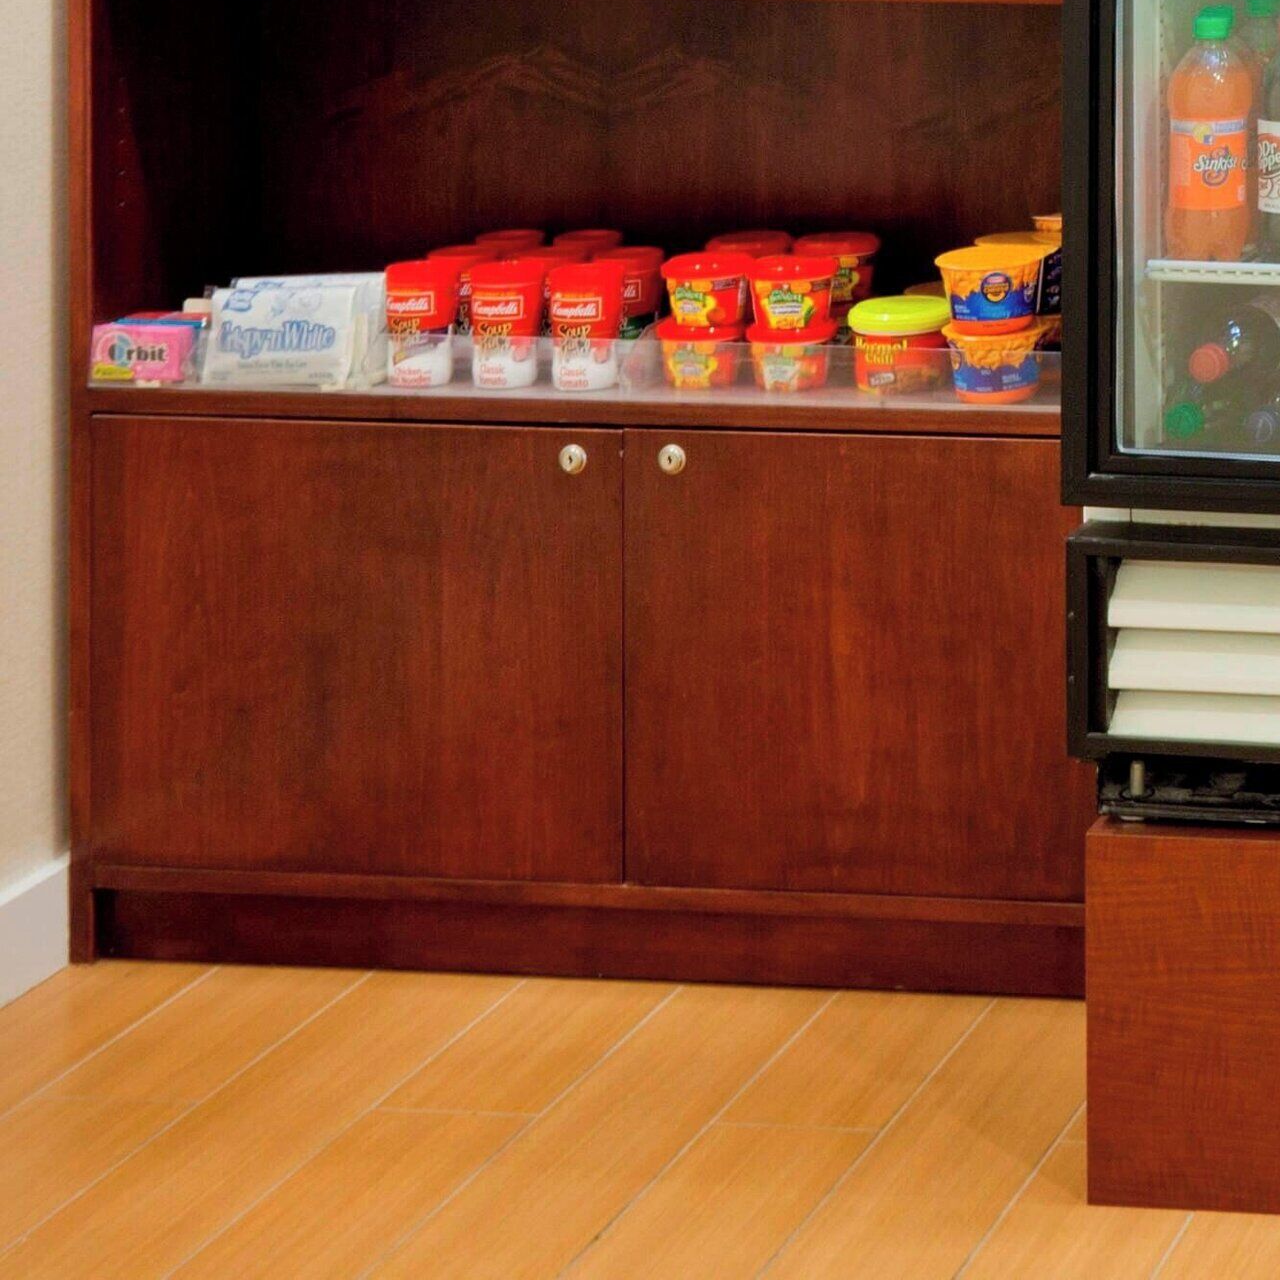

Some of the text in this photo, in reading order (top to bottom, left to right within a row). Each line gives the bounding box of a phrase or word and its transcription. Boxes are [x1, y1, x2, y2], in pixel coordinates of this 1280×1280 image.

[1261, 139, 1277, 156] Dr
[478, 322, 512, 338] Soup
[558, 324, 591, 340] Soup
[108, 342, 166, 362] Orbit
[856, 337, 908, 352] Hormel
[865, 351, 893, 365] Chili
